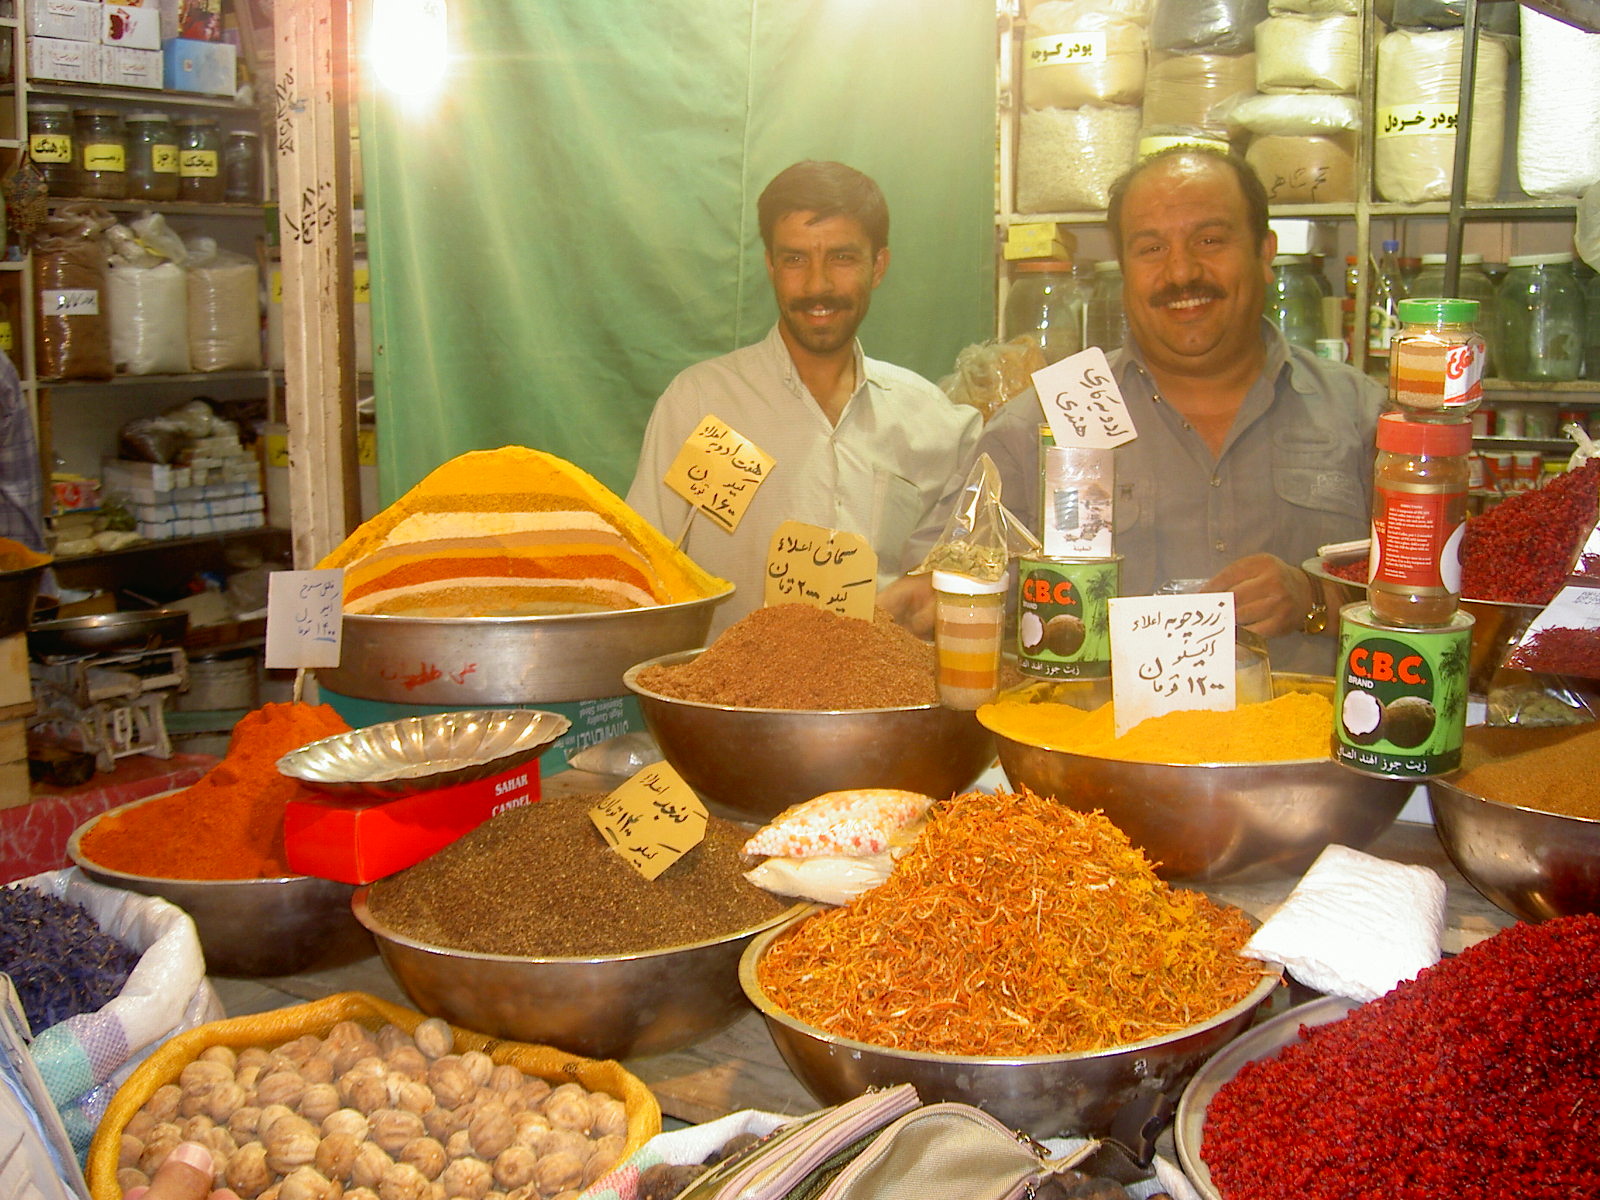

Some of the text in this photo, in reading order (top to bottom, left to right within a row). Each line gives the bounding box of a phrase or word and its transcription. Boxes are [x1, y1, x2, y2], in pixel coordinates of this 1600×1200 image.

[1384, 110, 1426, 132] خردل
[1056, 392, 1086, 437] هندی
[1087, 402, 1129, 437] ادویه
[705, 443, 743, 456] ادویه
[731, 458, 762, 475] هفت
[722, 478, 759, 497] کیلو
[813, 539, 858, 566] سماق
[300, 577, 322, 599] سرخ
[768, 562, 795, 595] تومان
[826, 579, 872, 613] کیلو
[1023, 578, 1077, 605] C.B.C.
[1164, 601, 1225, 644] زردچوبه
[1045, 665, 1060, 676] جوز
[1139, 657, 1180, 697] تومان
[1350, 647, 1427, 685] C.B.C.
[1347, 675, 1374, 689] BRAND
[1381, 759, 1402, 771] جوز
[495, 773, 529, 796] SAHAR
